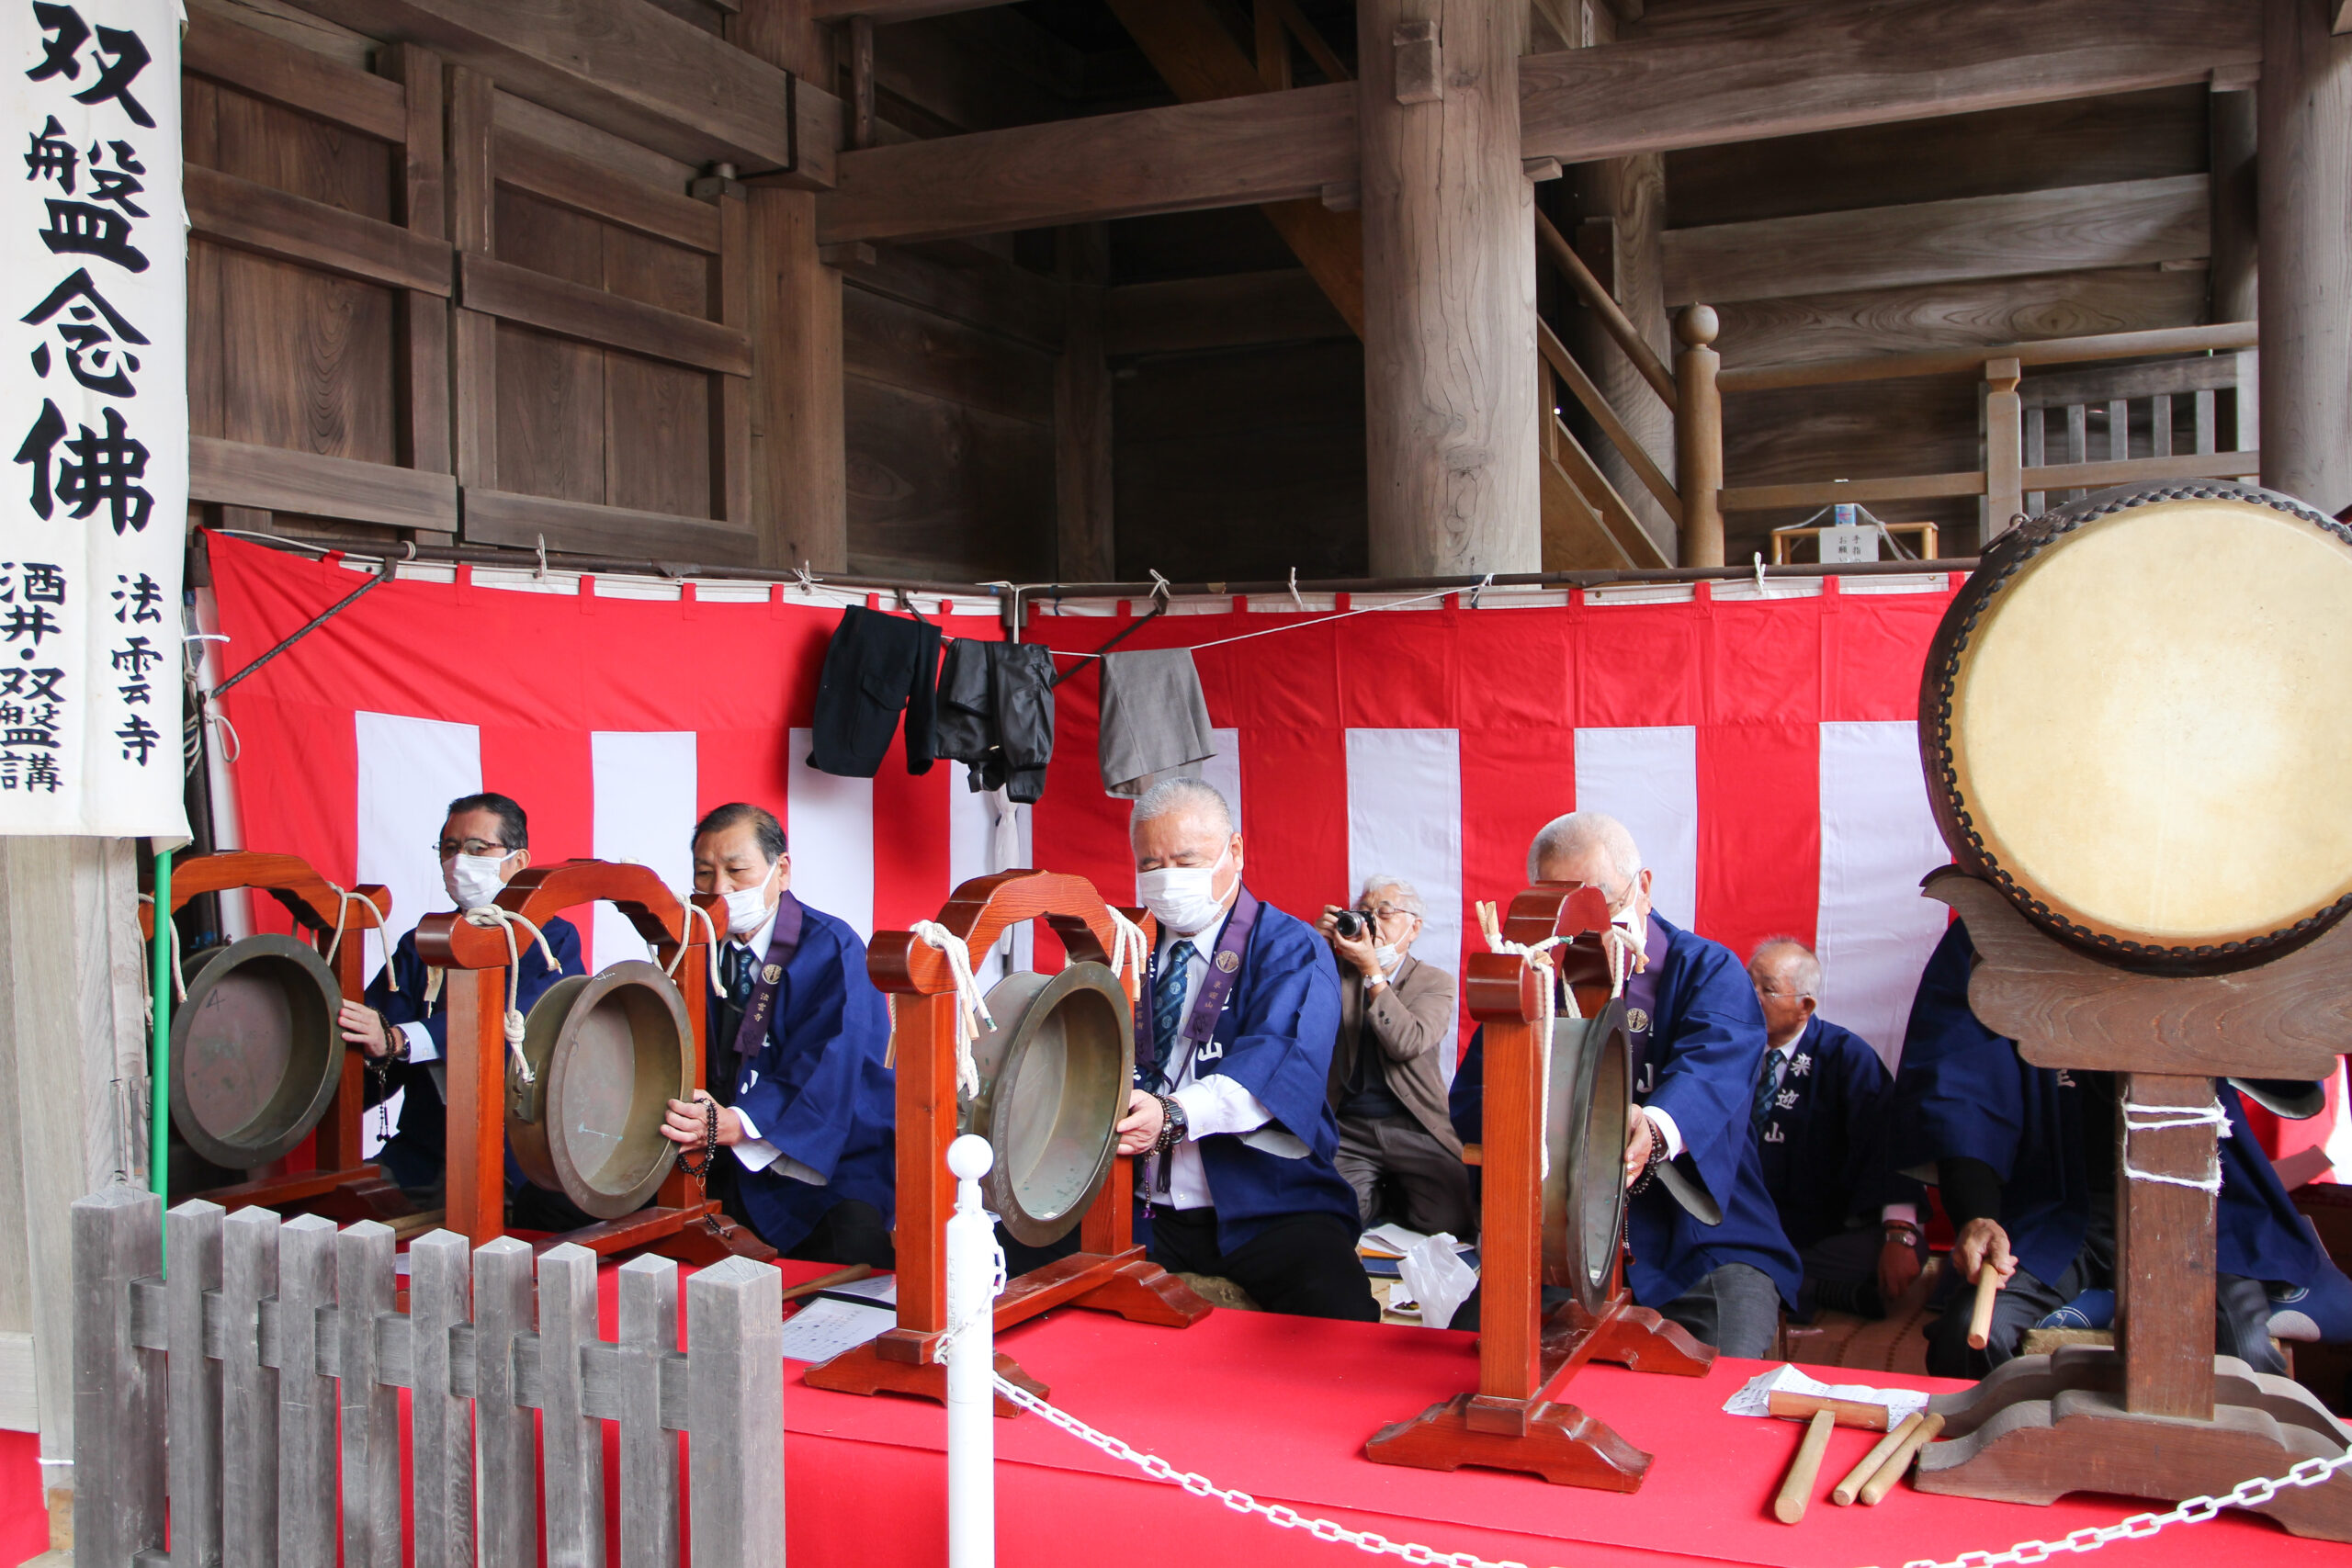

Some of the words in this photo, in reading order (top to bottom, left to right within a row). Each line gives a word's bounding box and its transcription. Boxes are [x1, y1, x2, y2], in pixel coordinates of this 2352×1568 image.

[13, 0, 157, 537] 双盤念佛
[0, 561, 67, 794] 酒井・双盤講
[110, 572, 164, 767] 法雲寺
[1764, 1052, 1813, 1144] 来迎山
